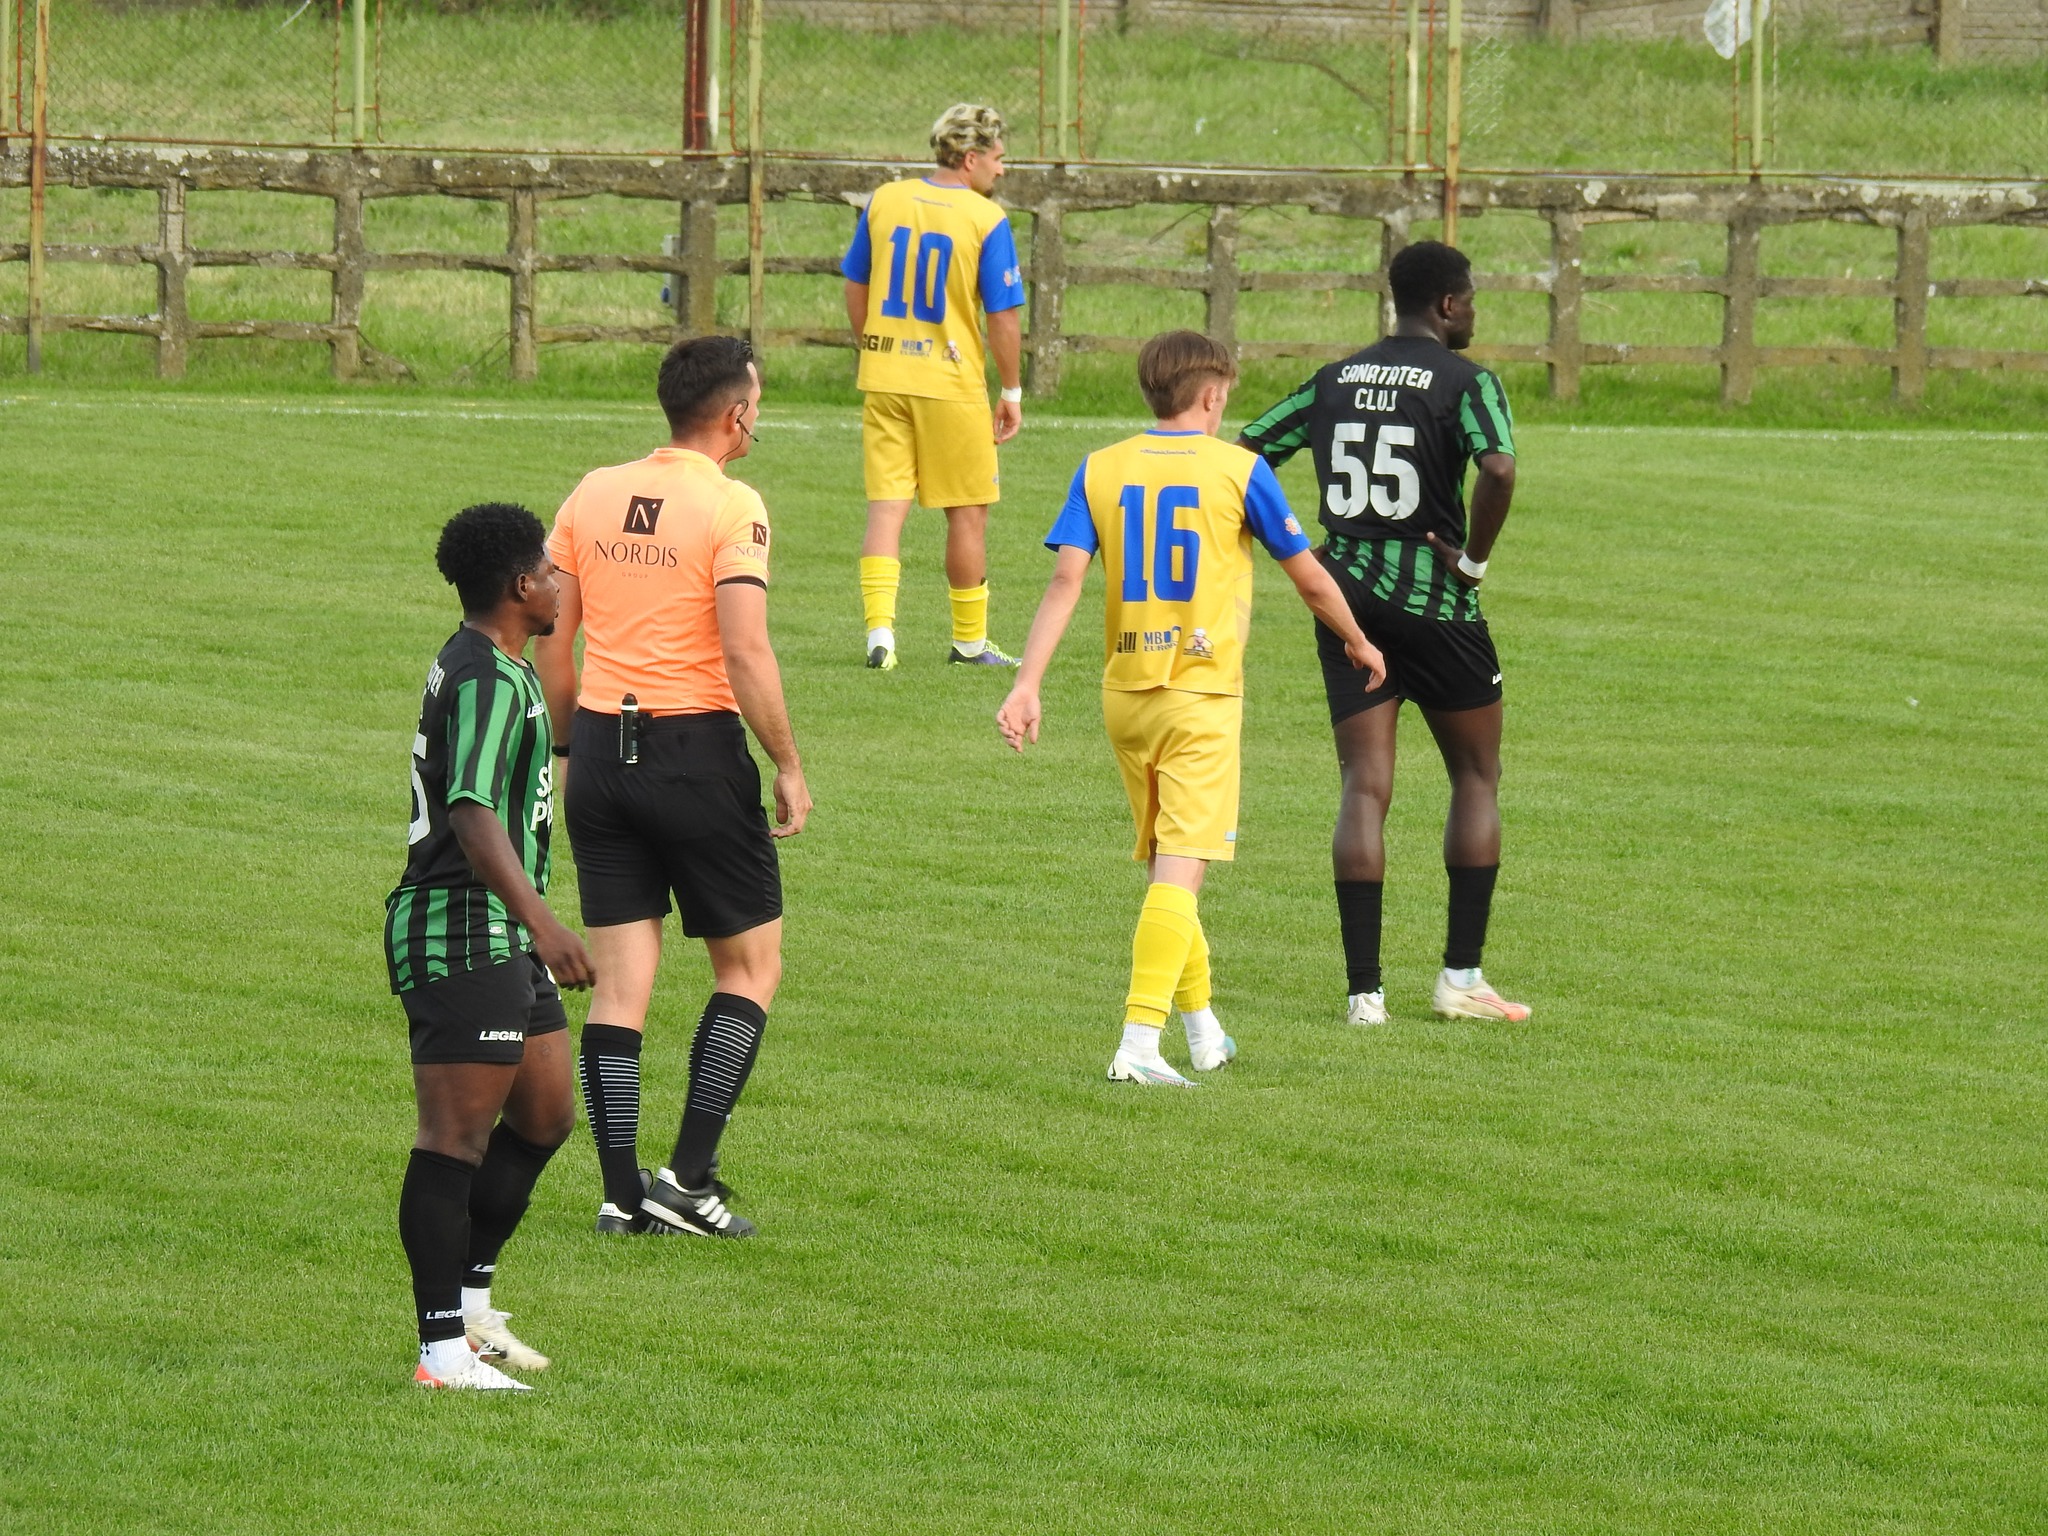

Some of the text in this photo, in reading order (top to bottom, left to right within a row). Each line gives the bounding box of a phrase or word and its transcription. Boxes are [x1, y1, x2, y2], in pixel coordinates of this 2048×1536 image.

[881, 226, 953, 325] 10
[1337, 363, 1433, 390] SANATATEA
[1354, 388, 1398, 412] CLUJ
[1326, 422, 1420, 520] 55
[594, 540, 678, 568] NORDIS
[1119, 485, 1200, 602] 16
[479, 1030, 523, 1042] LEGEA
